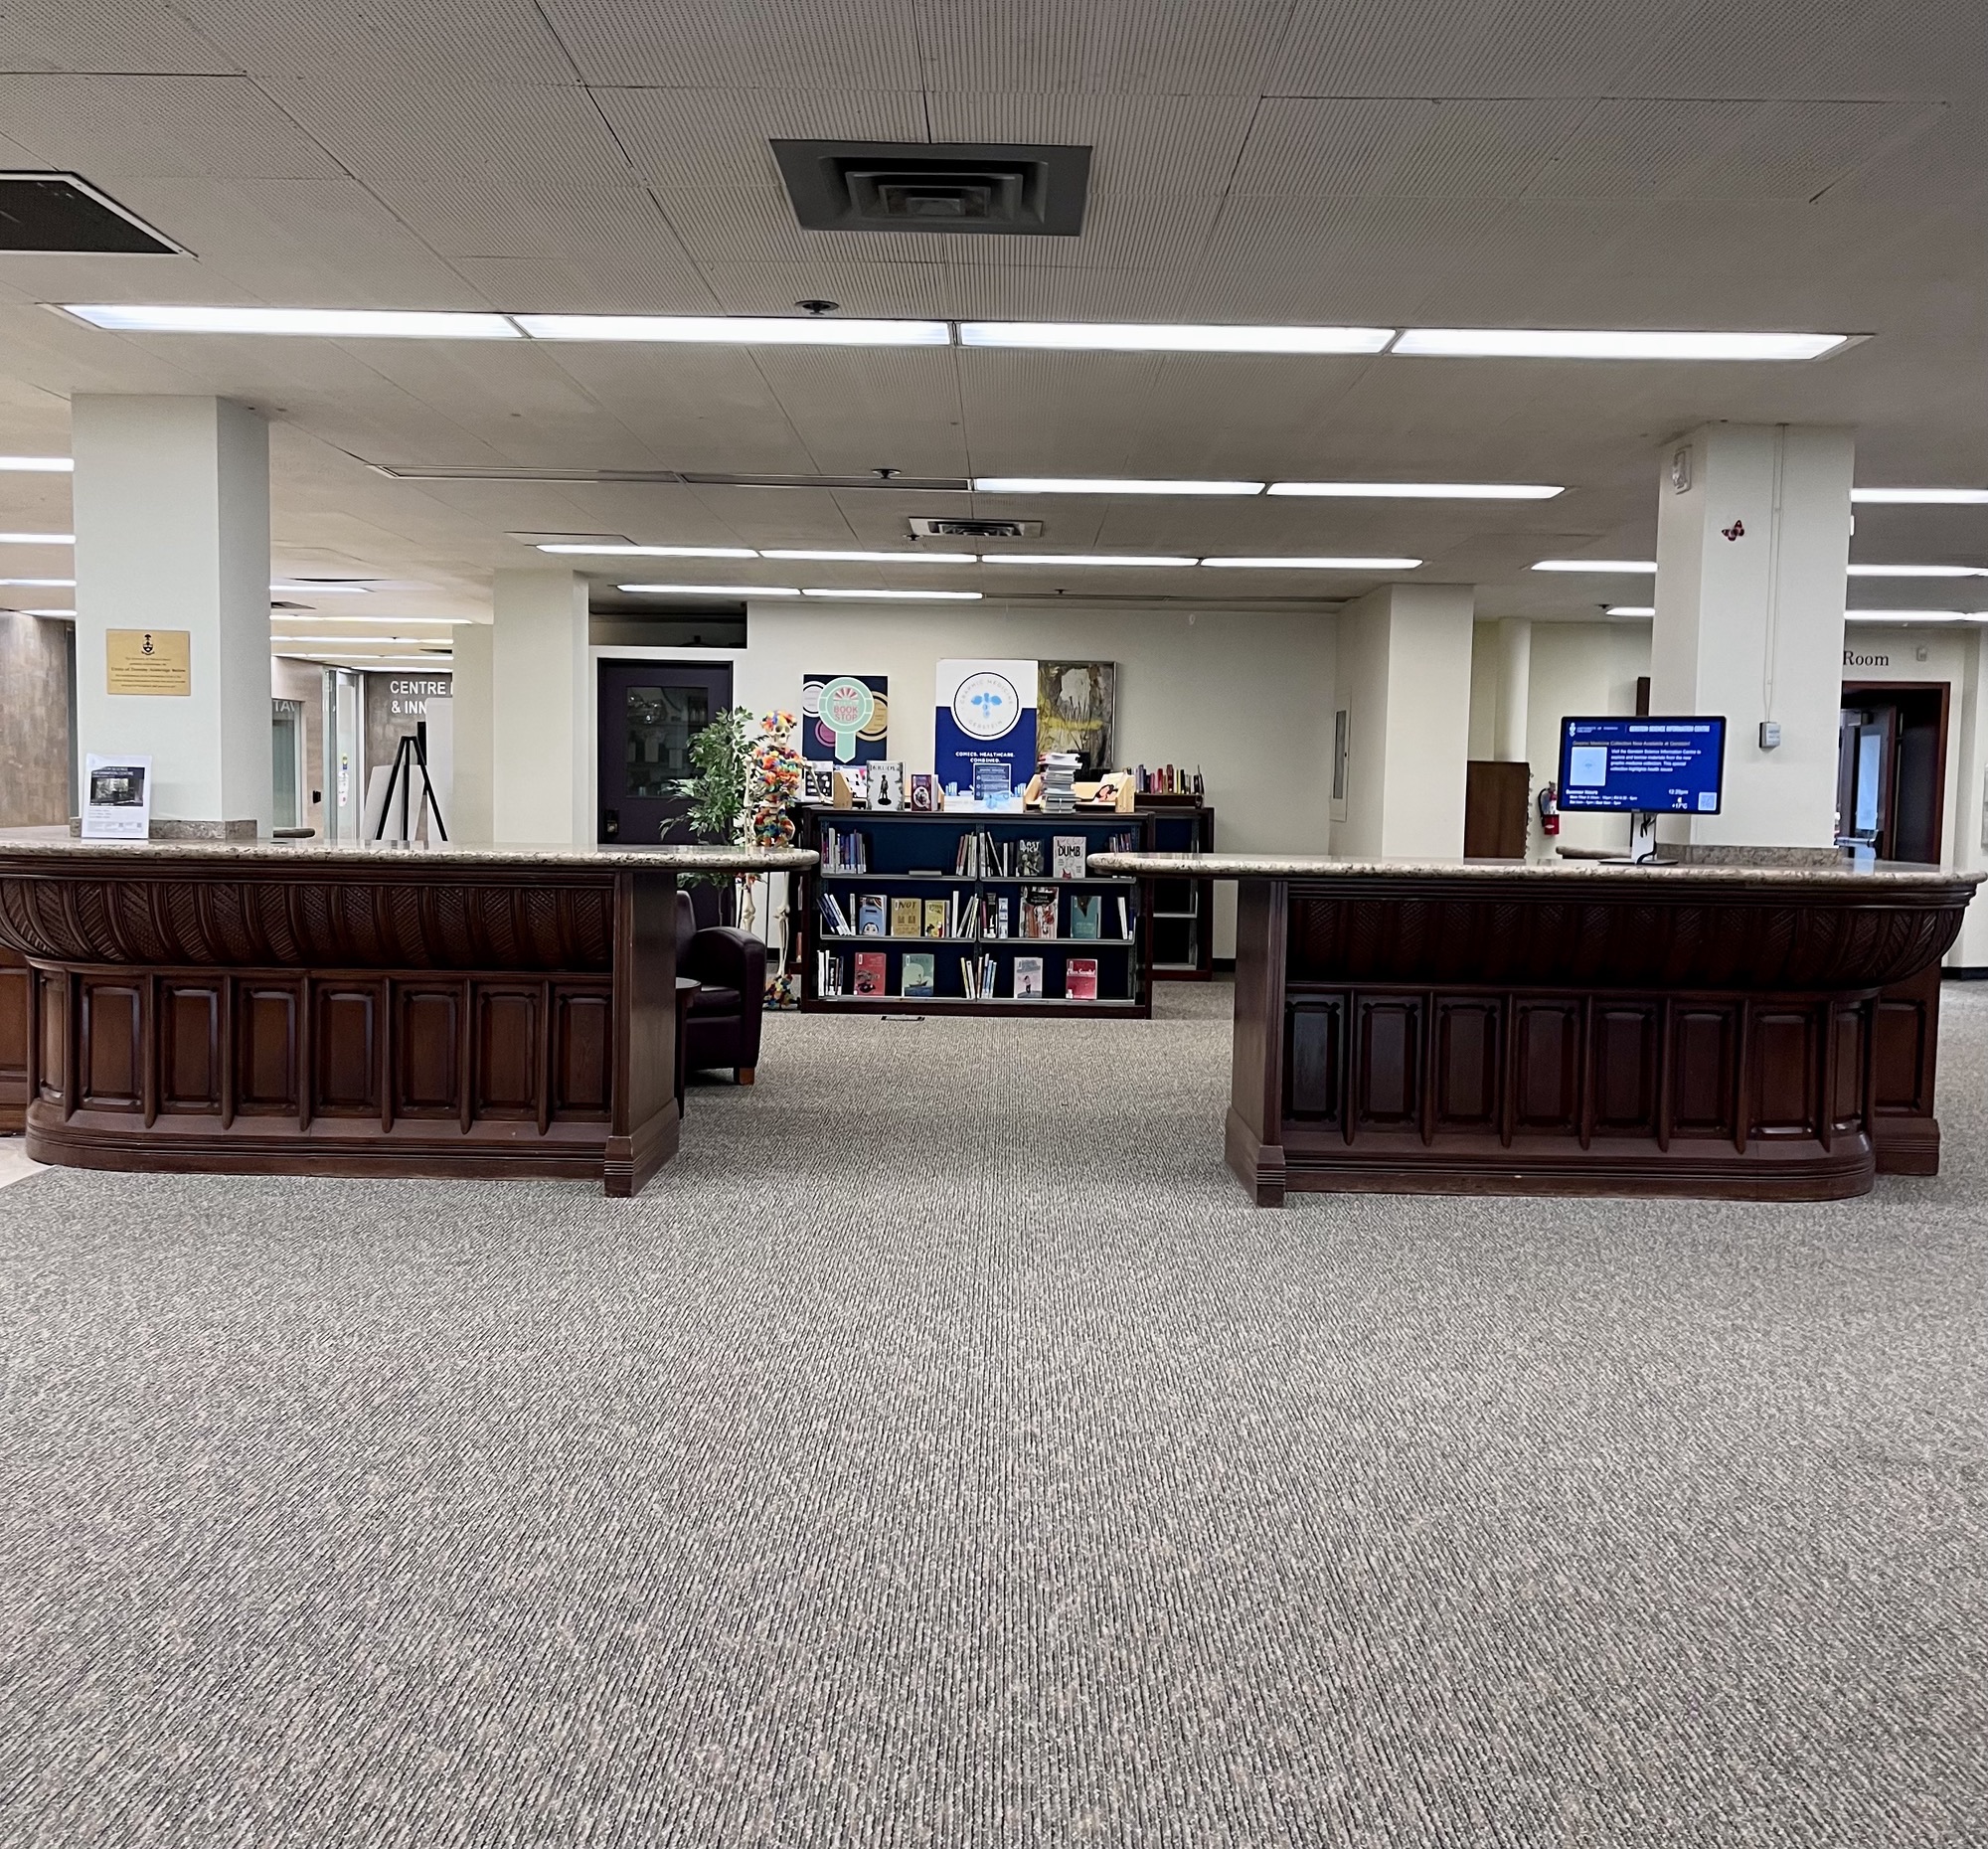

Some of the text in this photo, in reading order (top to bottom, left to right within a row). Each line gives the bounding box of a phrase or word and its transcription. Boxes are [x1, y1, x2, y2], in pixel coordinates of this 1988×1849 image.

[1843, 650, 1889, 666] Room
[390, 680, 446, 695] CENTRE
[391, 700, 401, 714] &
[833, 705, 858, 714] BOOK
[834, 713, 858, 722] STOP
[1058, 845, 1080, 857] DUMB
